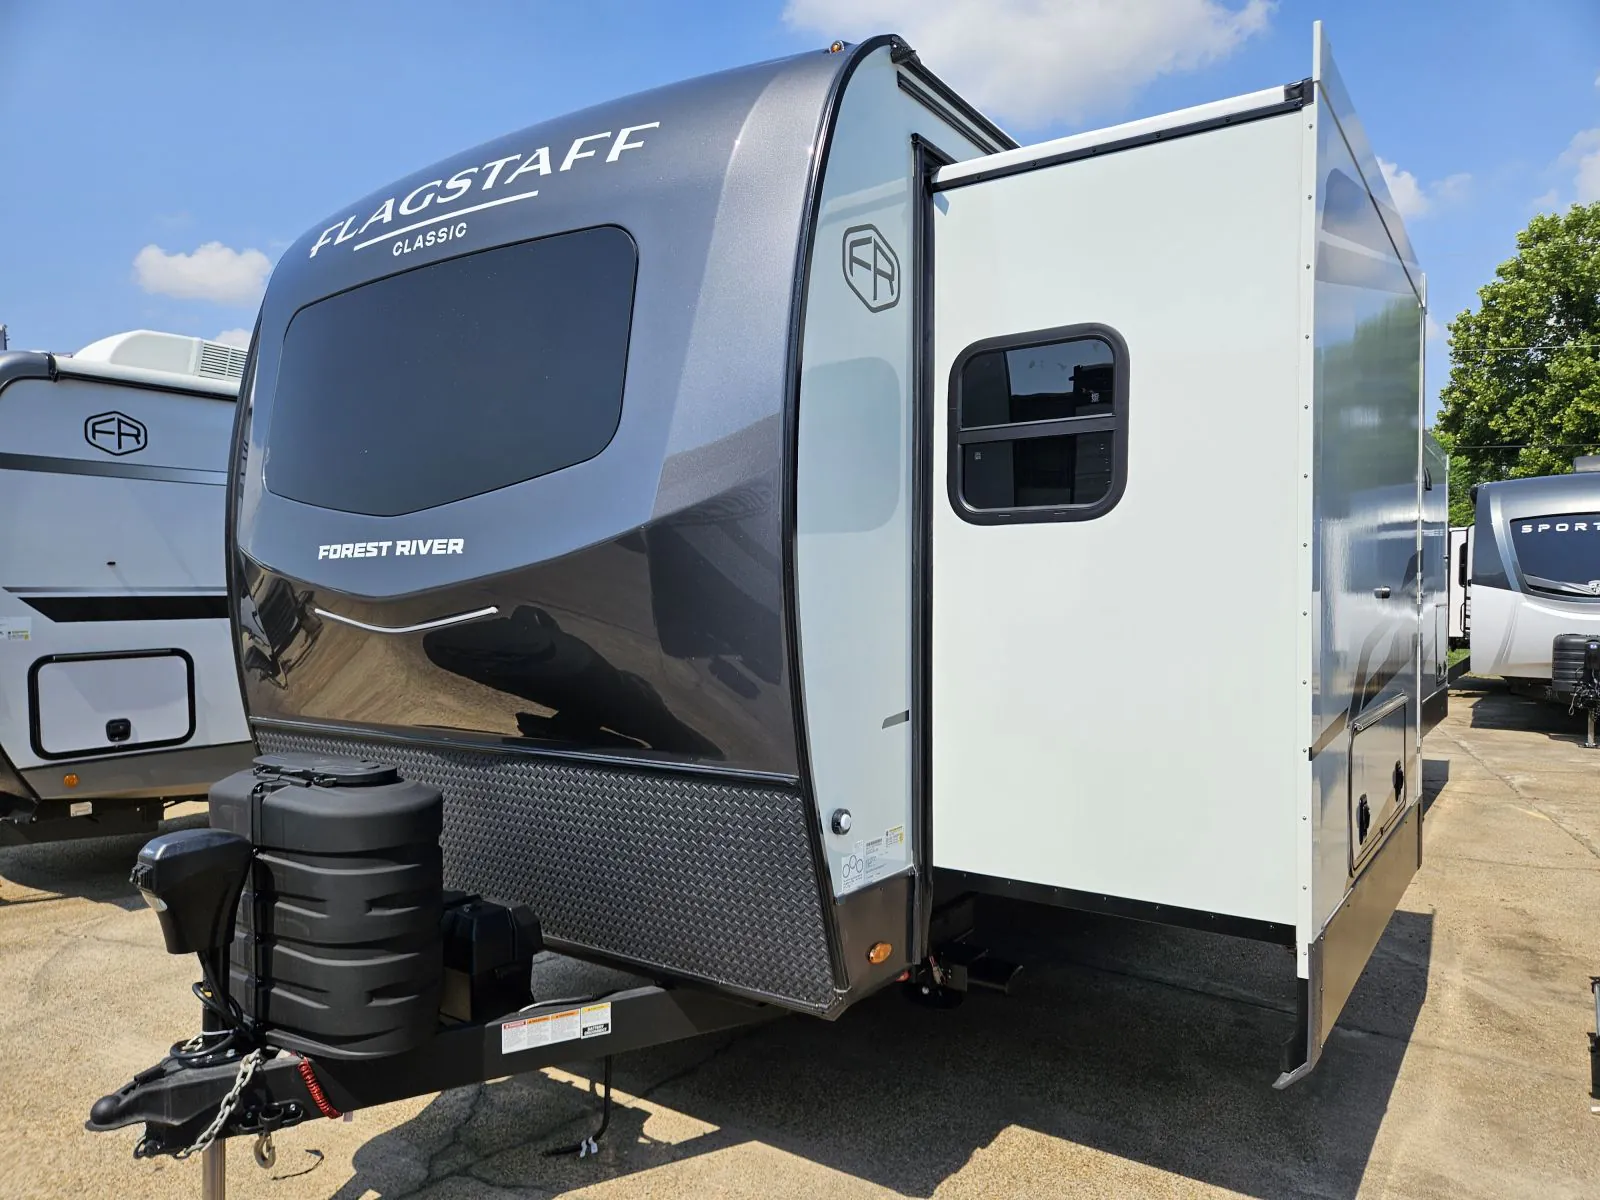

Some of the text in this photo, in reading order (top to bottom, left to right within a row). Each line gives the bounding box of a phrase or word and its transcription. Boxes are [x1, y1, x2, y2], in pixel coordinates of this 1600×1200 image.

[309, 121, 660, 258] FLAGSTAFF
[392, 222, 467, 257] CLASSIC
[91, 416, 141, 450] FR
[318, 538, 465, 560] FOREST RIVER
